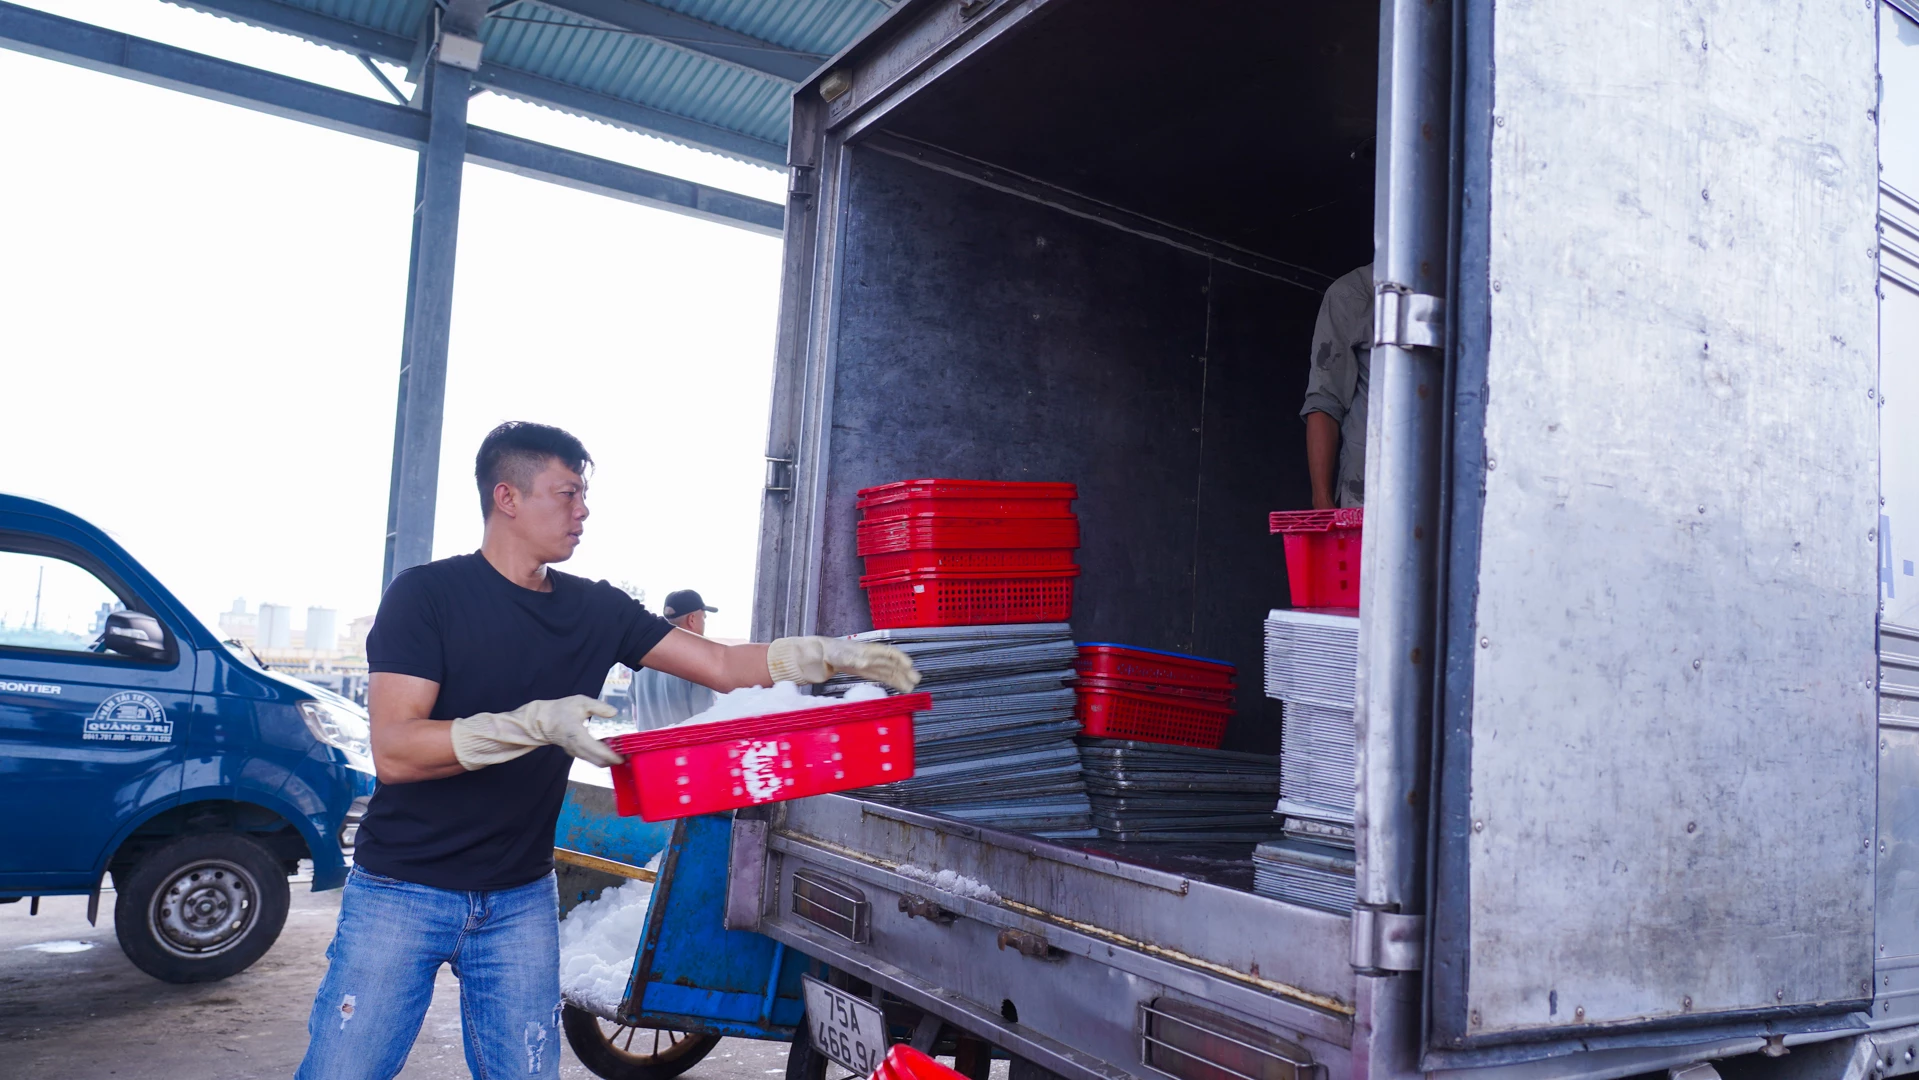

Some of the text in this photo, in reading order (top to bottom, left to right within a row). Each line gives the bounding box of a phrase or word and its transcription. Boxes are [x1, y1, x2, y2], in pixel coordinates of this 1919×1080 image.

[88, 722, 169, 734] QUẢNG TRỊ
[823, 989, 862, 1036] 75A
